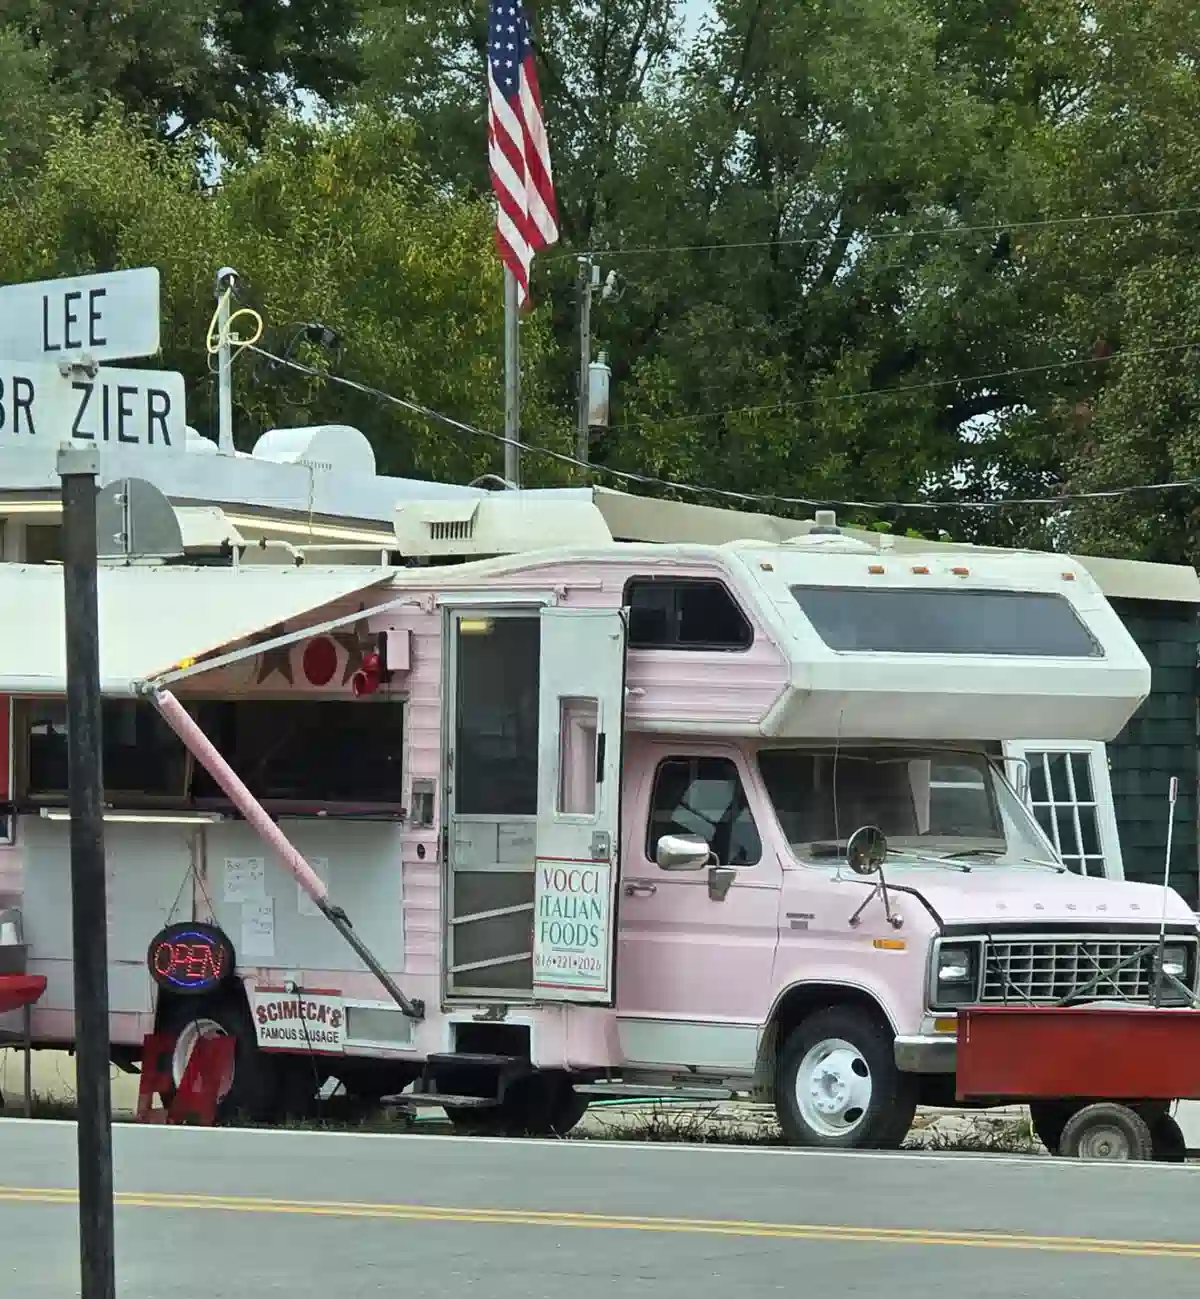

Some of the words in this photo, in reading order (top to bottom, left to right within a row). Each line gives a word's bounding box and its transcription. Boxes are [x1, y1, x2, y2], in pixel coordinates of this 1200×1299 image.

[43, 288, 107, 352] LEE
[543, 868, 599, 894] VOCCI
[539, 895, 601, 921] ITALIAN
[540, 921, 599, 948] FOODS
[154, 942, 224, 979] OPEN
[260, 1027, 298, 1041] FAMOUS
